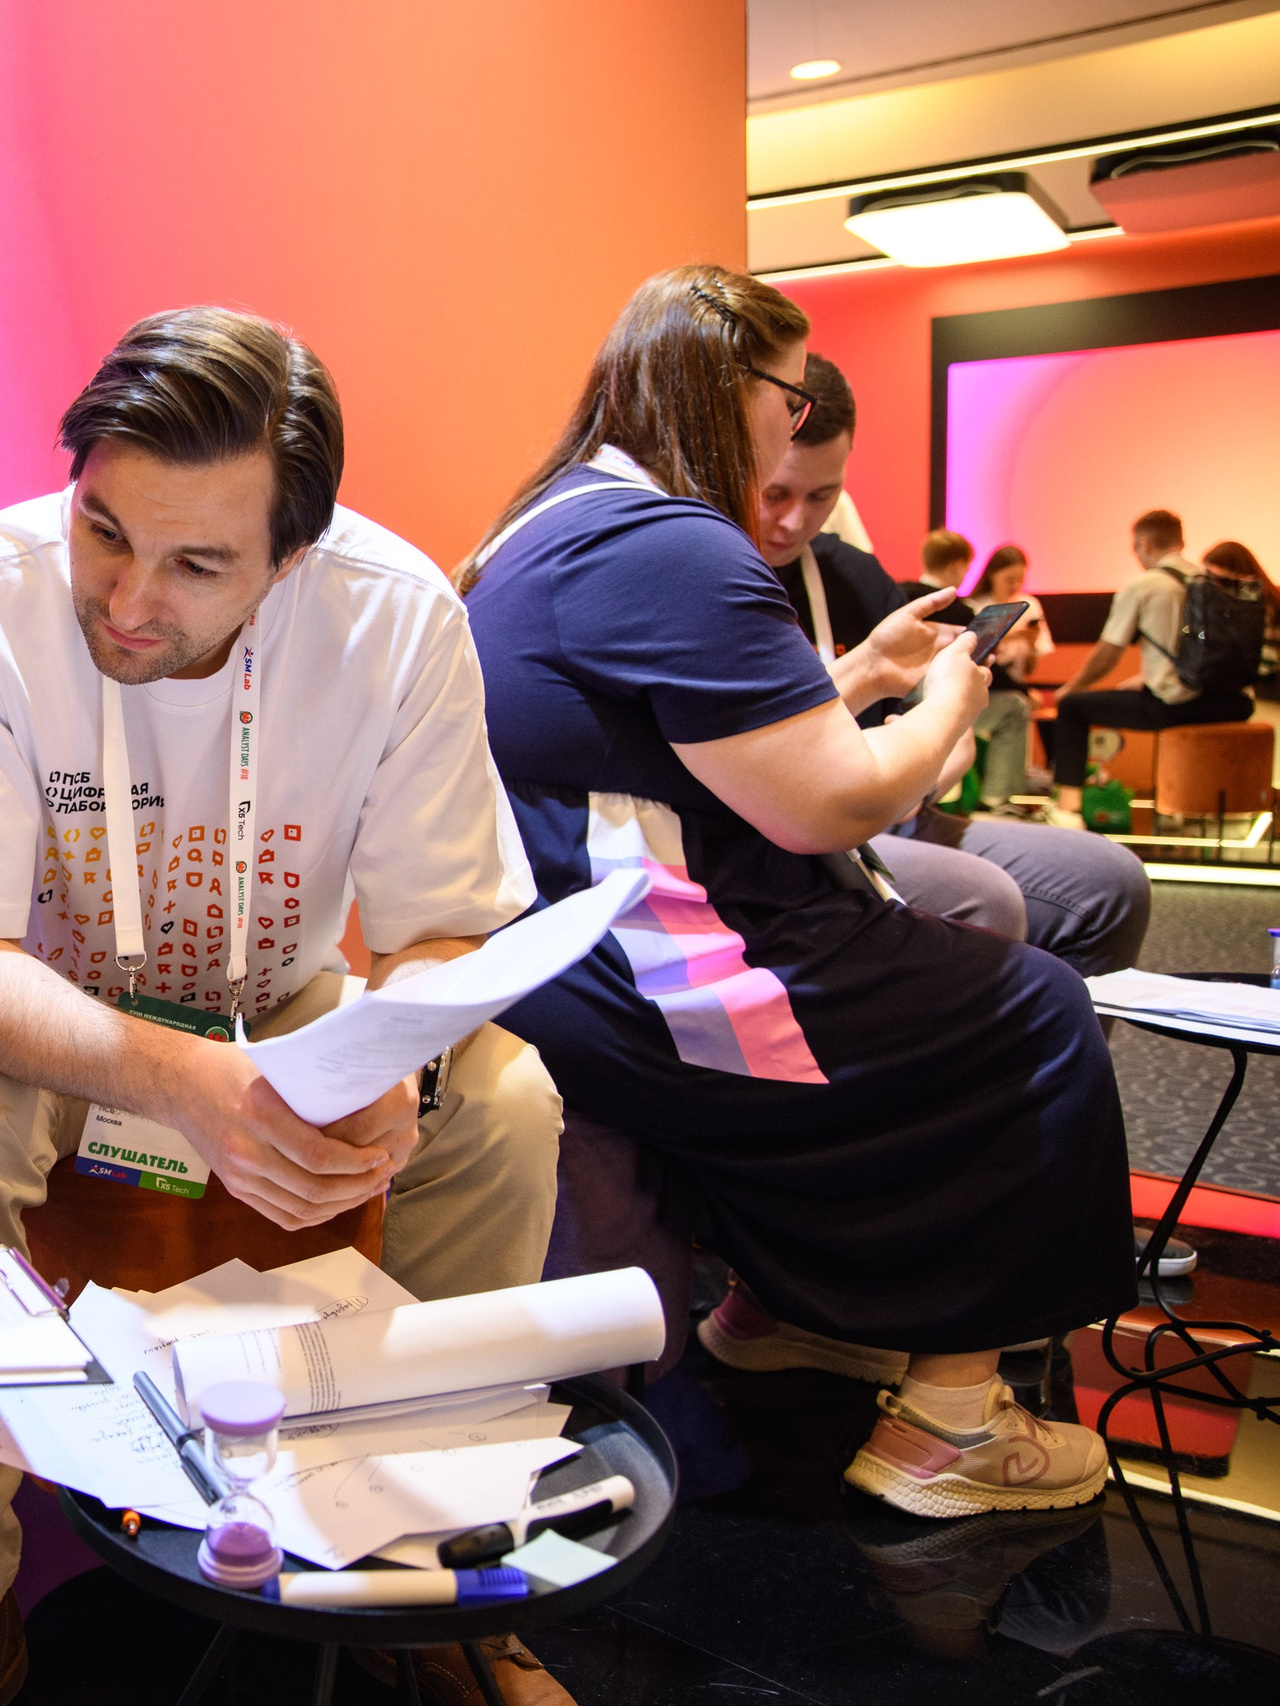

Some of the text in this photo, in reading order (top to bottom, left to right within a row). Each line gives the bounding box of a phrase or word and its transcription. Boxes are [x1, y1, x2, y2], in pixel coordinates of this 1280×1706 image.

[240, 727, 251, 781] ANALYST DAYS #18
[62, 771, 91, 786] ПСБ
[60, 782, 149, 802] ЦИФРАЯ
[237, 820, 246, 841] Tech
[236, 876, 245, 901] ANALYST
[236, 902, 245, 916] DAYS
[143, 1013, 197, 1031] МЕЖДУНАРОДНАЯ
[96, 1115, 122, 1126] Москва
[87, 1141, 189, 1174] СЛУШАТЕЛЬ
[99, 1167, 126, 1179] SM Lab
[171, 1184, 189, 1195] Tech
